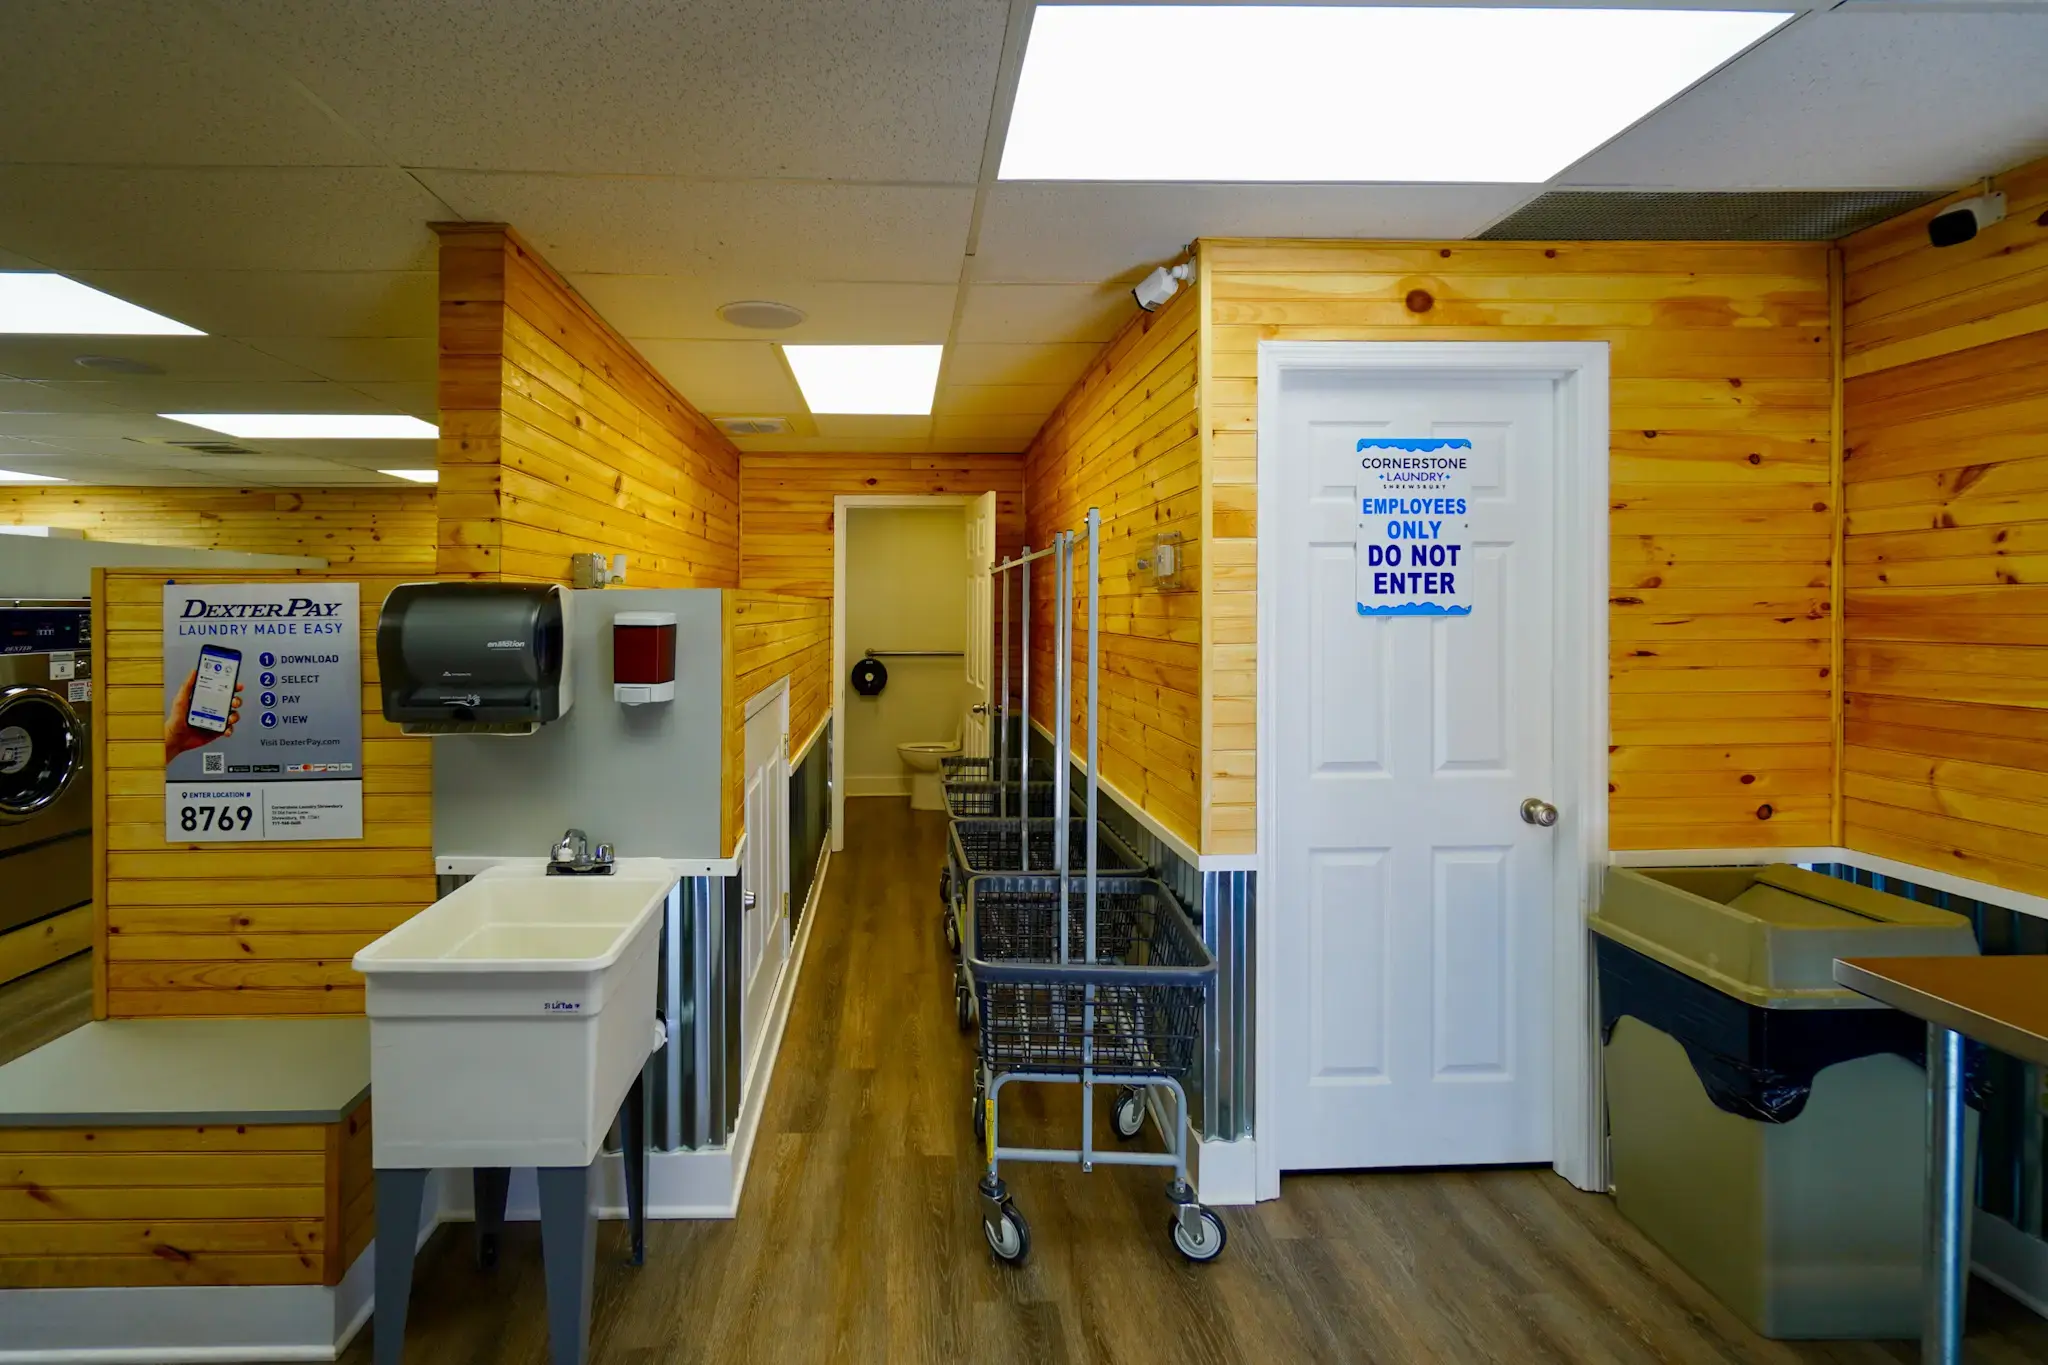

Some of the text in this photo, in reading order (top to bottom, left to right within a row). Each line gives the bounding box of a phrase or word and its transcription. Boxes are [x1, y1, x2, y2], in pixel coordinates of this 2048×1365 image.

[1361, 457, 1467, 469] CORNERSTONE
[1386, 472, 1445, 482] LAUNDRY
[1362, 498, 1467, 515] EMPLOYEES
[1387, 520, 1442, 540] ONLY
[1368, 544, 1461, 567] DO NOT
[1374, 572, 1456, 595] ENTER
[179, 622, 343, 636] LAUNDRY MADE EASY
[263, 654, 339, 665] 1 DOWNLOAD
[264, 674, 320, 685] 2 SELECT
[264, 694, 301, 704] 3 PAY
[264, 715, 308, 725] 4 VIEW
[260, 738, 340, 747] Visit DexterPay.com
[181, 805, 253, 831] 8769
